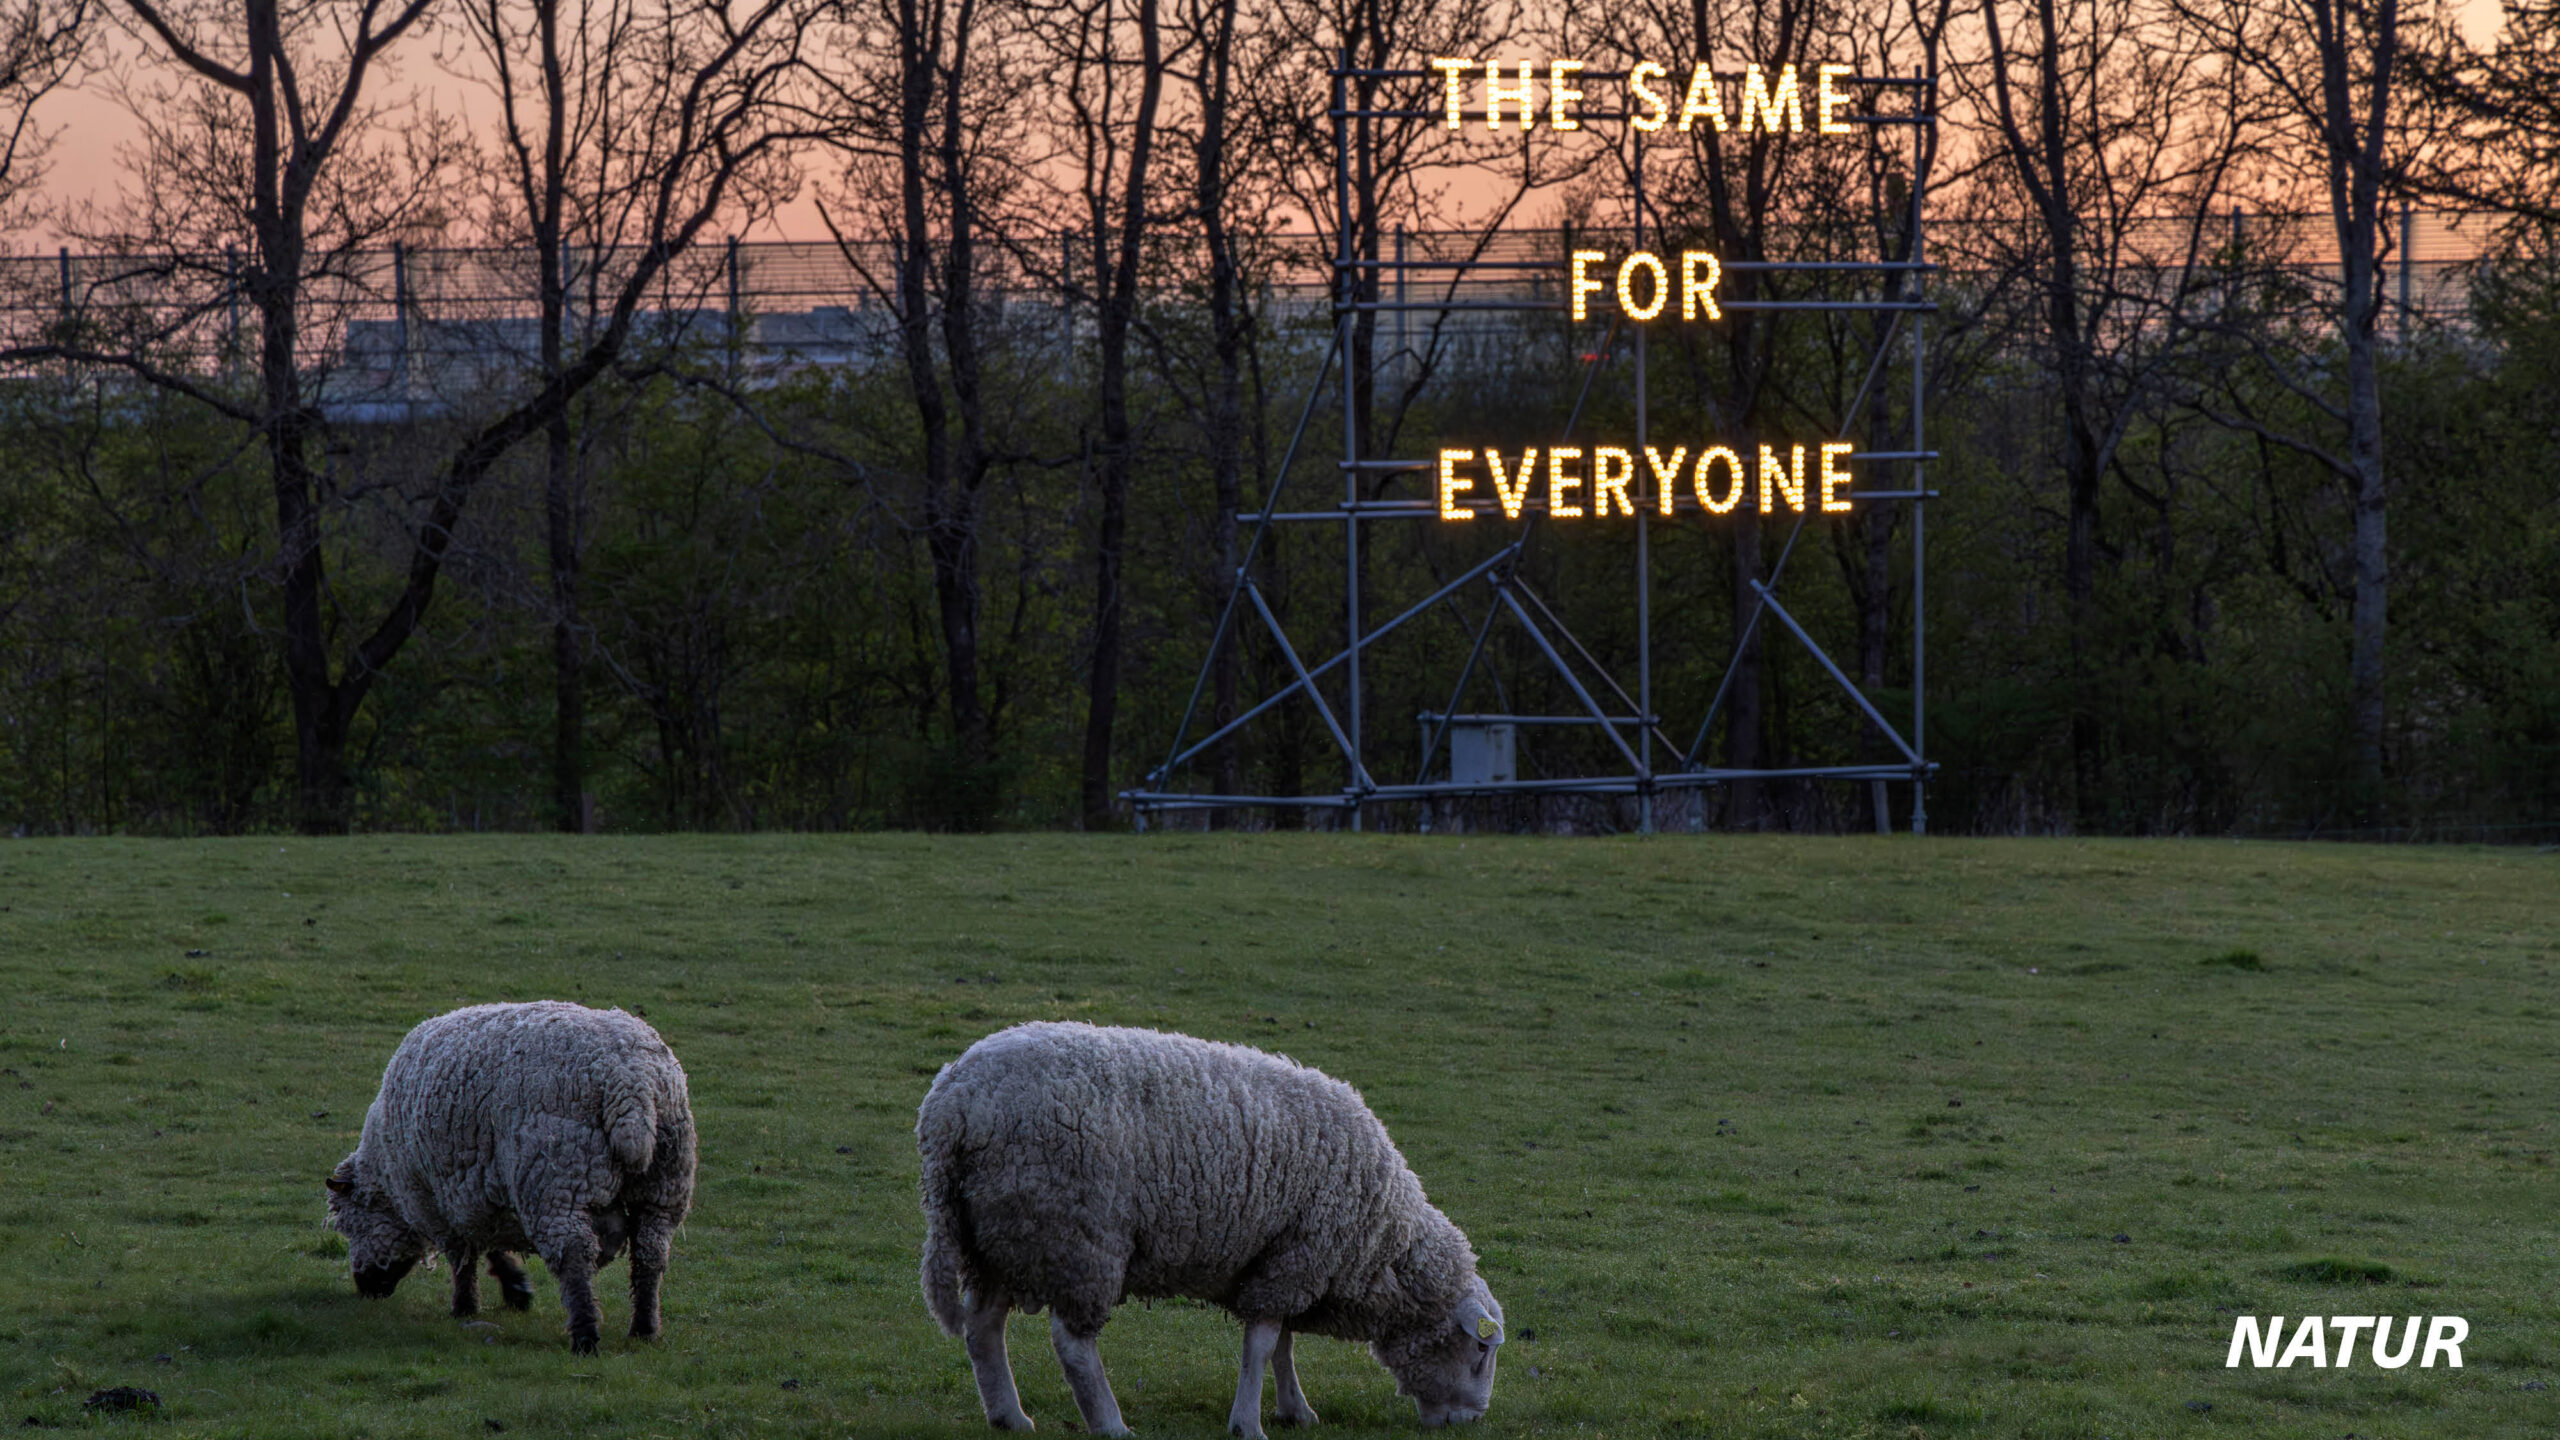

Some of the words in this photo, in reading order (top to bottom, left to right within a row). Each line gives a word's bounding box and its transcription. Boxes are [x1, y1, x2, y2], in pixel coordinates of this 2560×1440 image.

[1432, 58, 1585, 131] THE
[1630, 60, 1852, 134] SAME
[1572, 249, 1722, 321] FOR
[1439, 442, 1854, 521] EVERYONE
